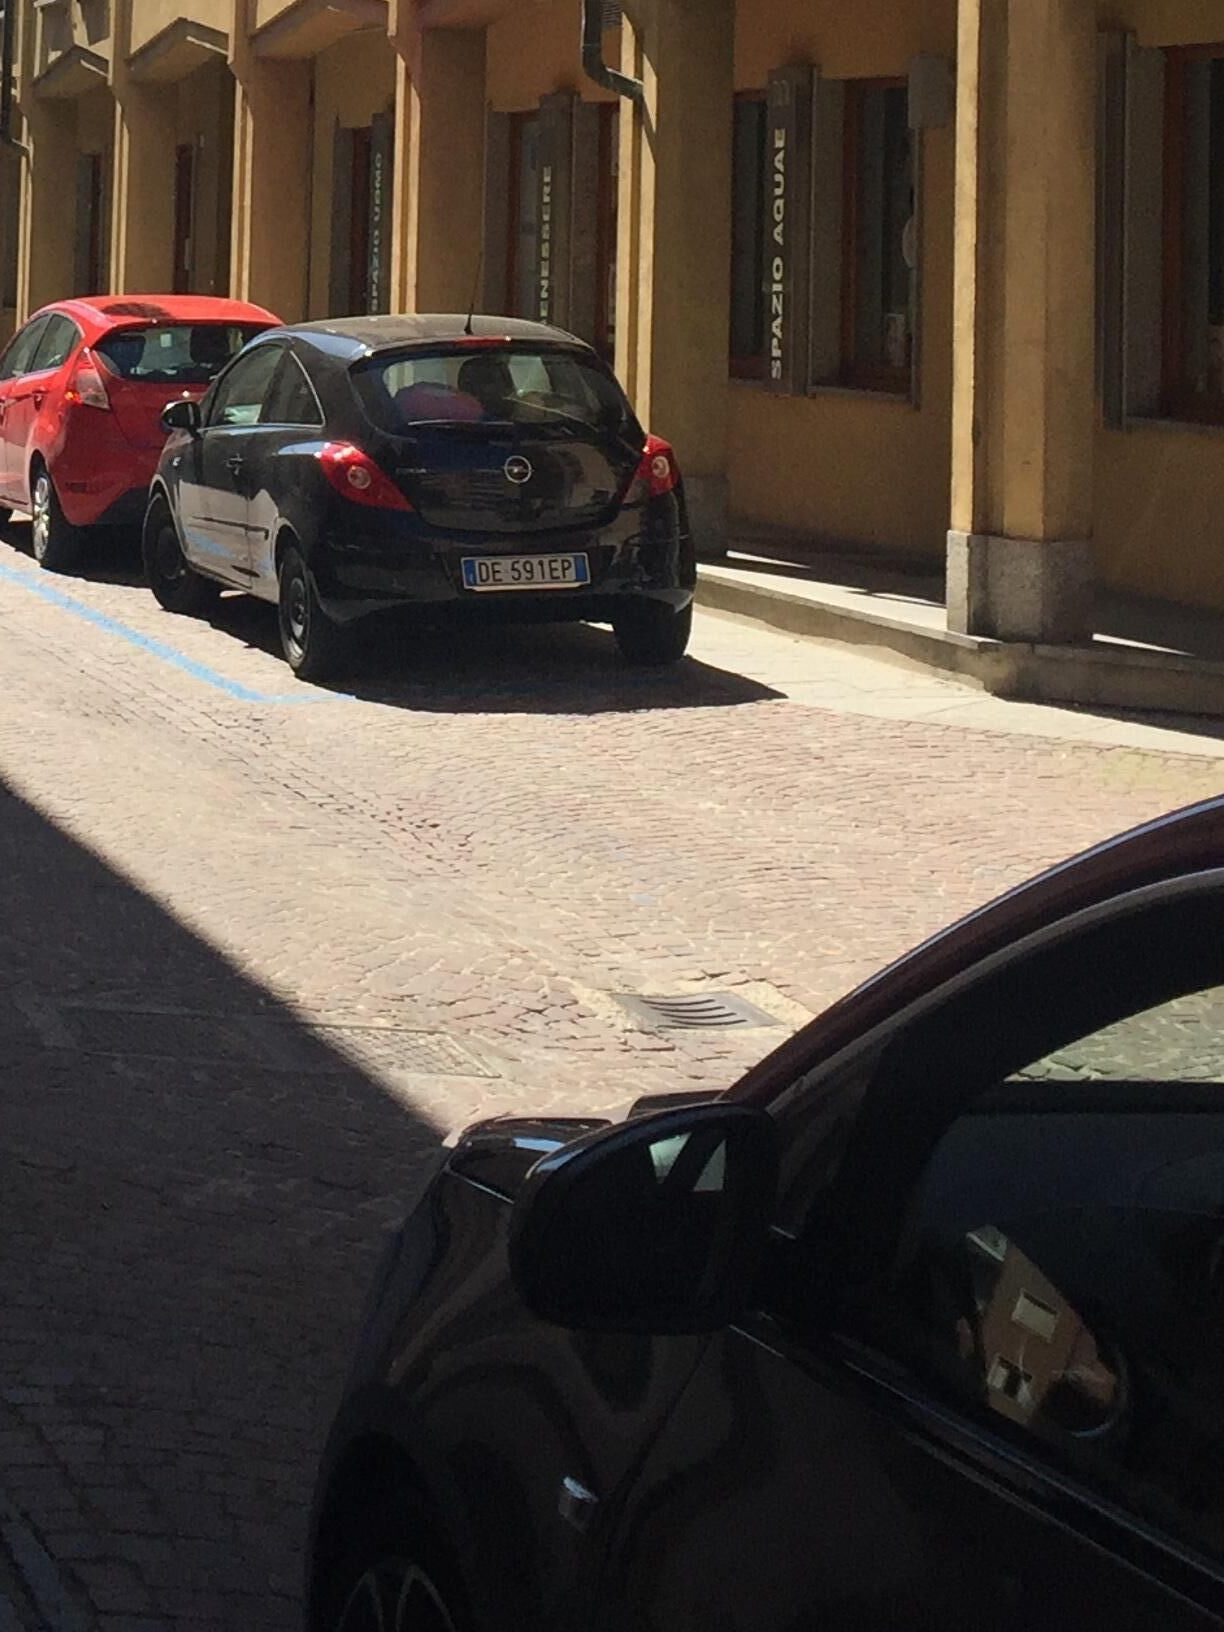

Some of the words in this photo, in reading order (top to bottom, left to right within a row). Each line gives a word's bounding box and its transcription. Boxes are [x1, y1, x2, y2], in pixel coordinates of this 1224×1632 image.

[773, 127, 786, 246] AQUAE
[771, 256, 784, 380] SPAZIO
[477, 561, 503, 583] DE
[510, 559, 572, 581] 591EP
